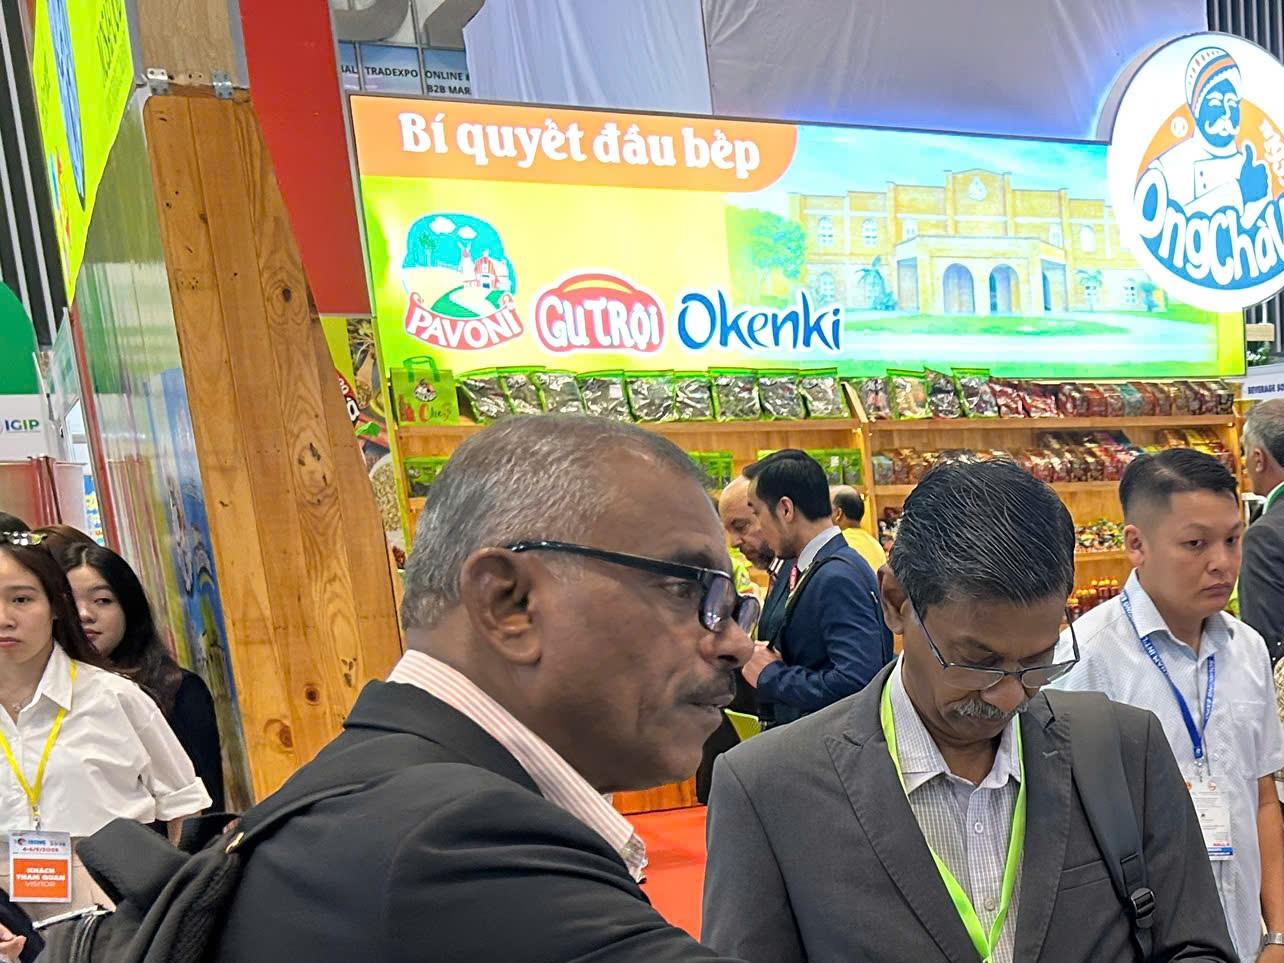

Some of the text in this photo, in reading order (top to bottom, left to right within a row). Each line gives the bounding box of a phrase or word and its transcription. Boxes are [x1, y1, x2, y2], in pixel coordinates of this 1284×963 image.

[365, 66, 463, 81] TRADEXPO ONLINE
[428, 84, 446, 94] B2B
[398, 112, 448, 154] Bí
[676, 289, 844, 354] Okenki
[4, 419, 40, 432] IGIP
